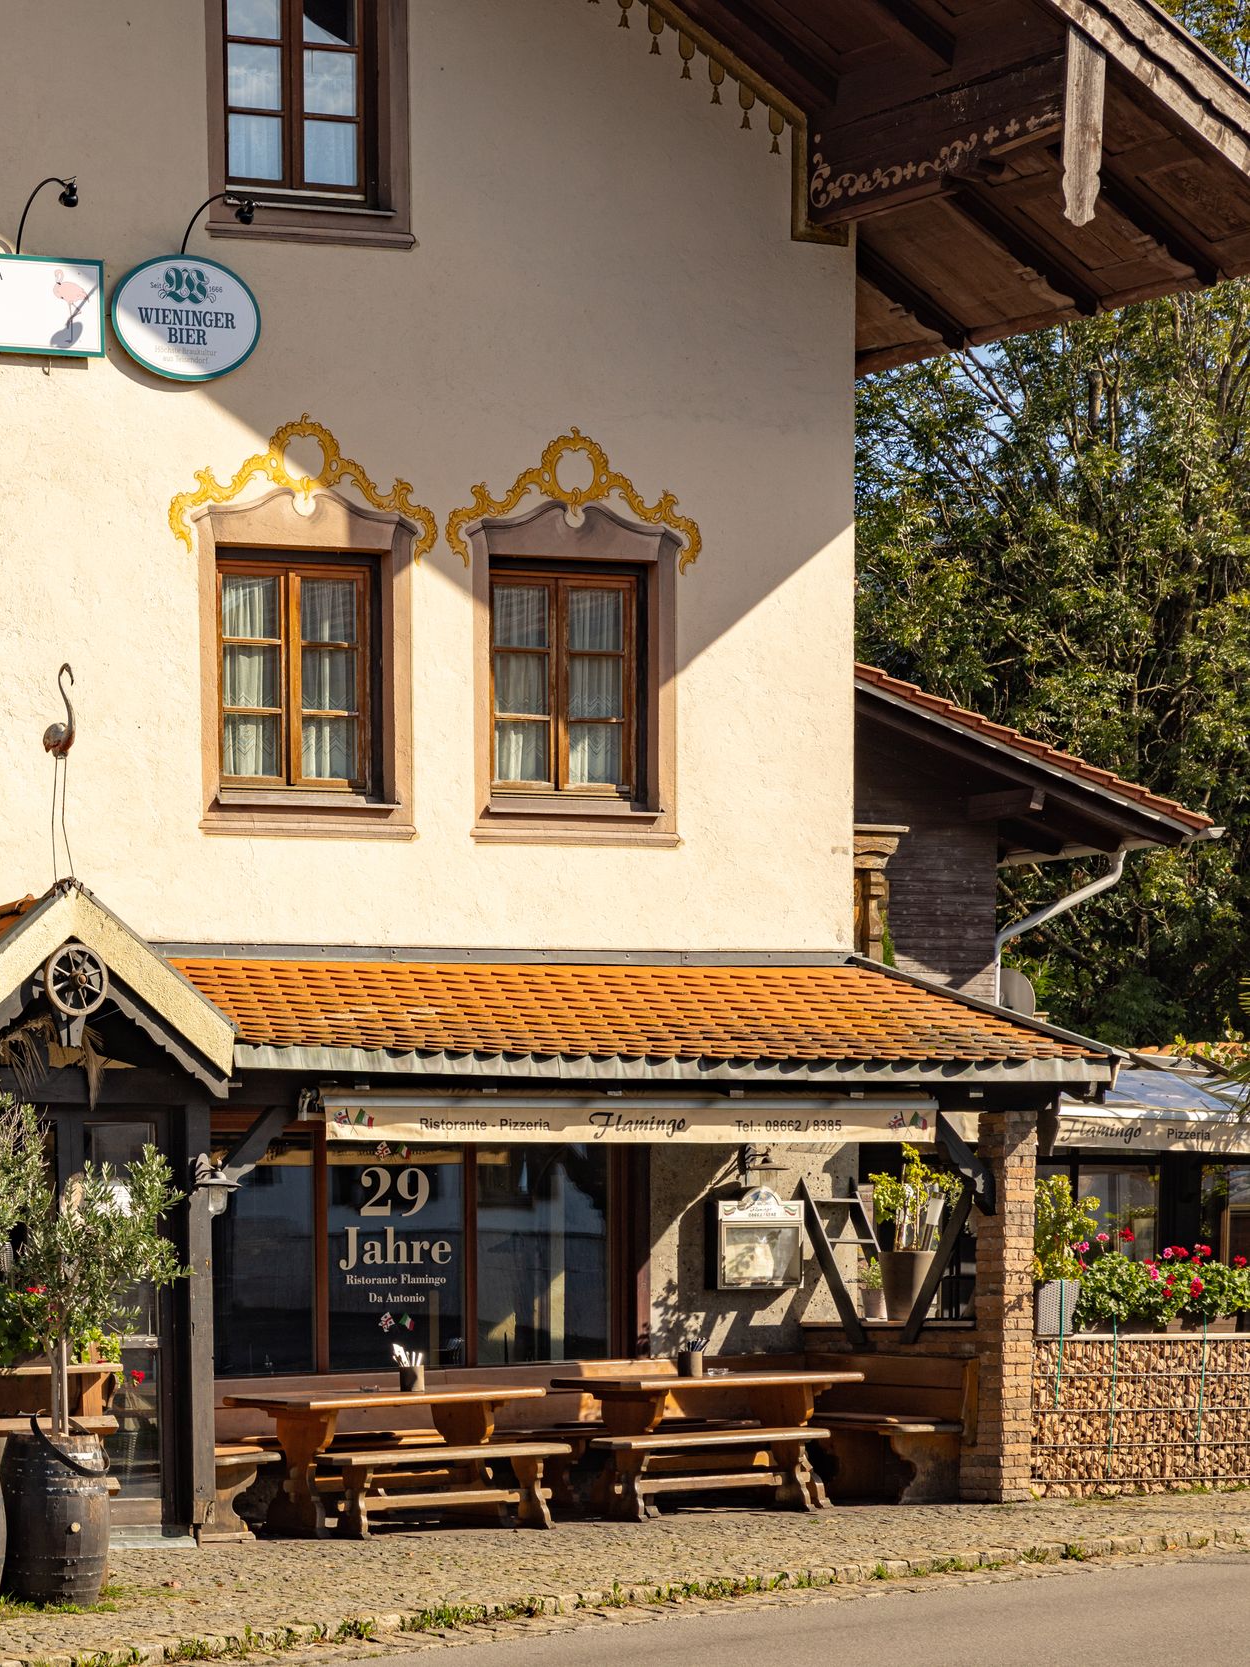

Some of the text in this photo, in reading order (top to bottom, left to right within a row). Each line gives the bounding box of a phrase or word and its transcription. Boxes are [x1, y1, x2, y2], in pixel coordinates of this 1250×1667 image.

[138, 307, 236, 329] WIENINGER
[167, 327, 207, 345] BIER
[419, 1117, 487, 1131] Ristorante
[500, 1117, 550, 1131] Pizzeria
[588, 1111, 686, 1139] Flamingo
[735, 1119, 761, 1132] Tel.:
[765, 1119, 801, 1132] 08662
[812, 1119, 842, 1132] 8385
[1060, 1117, 1211, 1145] Flamingo Pizzeria
[360, 1167, 430, 1217] 29
[339, 1226, 452, 1270] Jahre
[345, 1273, 447, 1286] Ristorante Flamingo
[369, 1293, 425, 1303] Da Antonio
